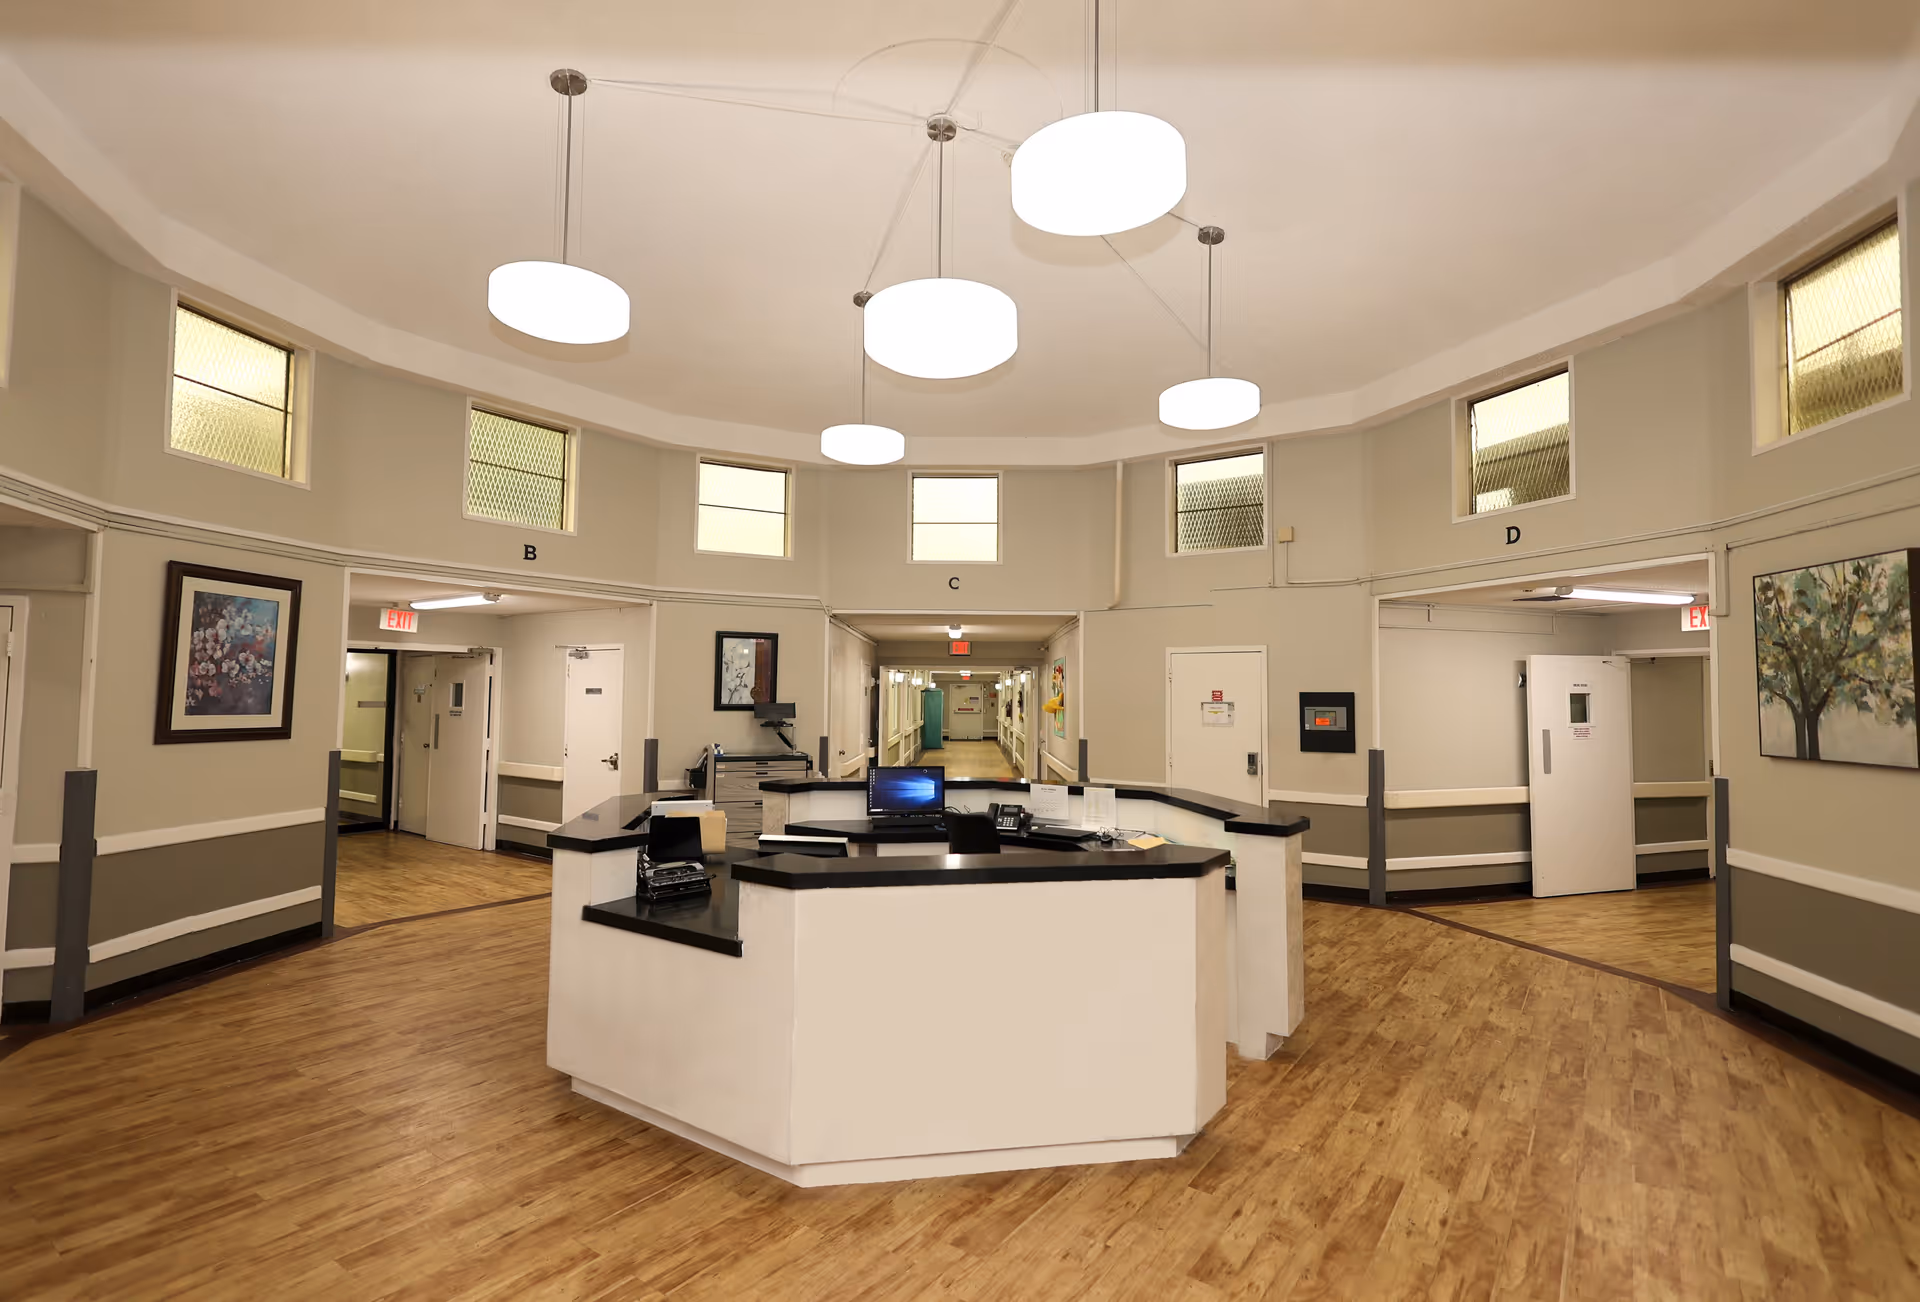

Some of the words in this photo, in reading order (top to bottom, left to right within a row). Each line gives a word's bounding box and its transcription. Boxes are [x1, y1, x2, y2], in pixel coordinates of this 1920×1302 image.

[1505, 525, 1521, 545] D
[523, 544, 537, 561] B
[948, 576, 960, 590] C
[387, 608, 415, 630] EXIT
[1689, 605, 1708, 628] EX
